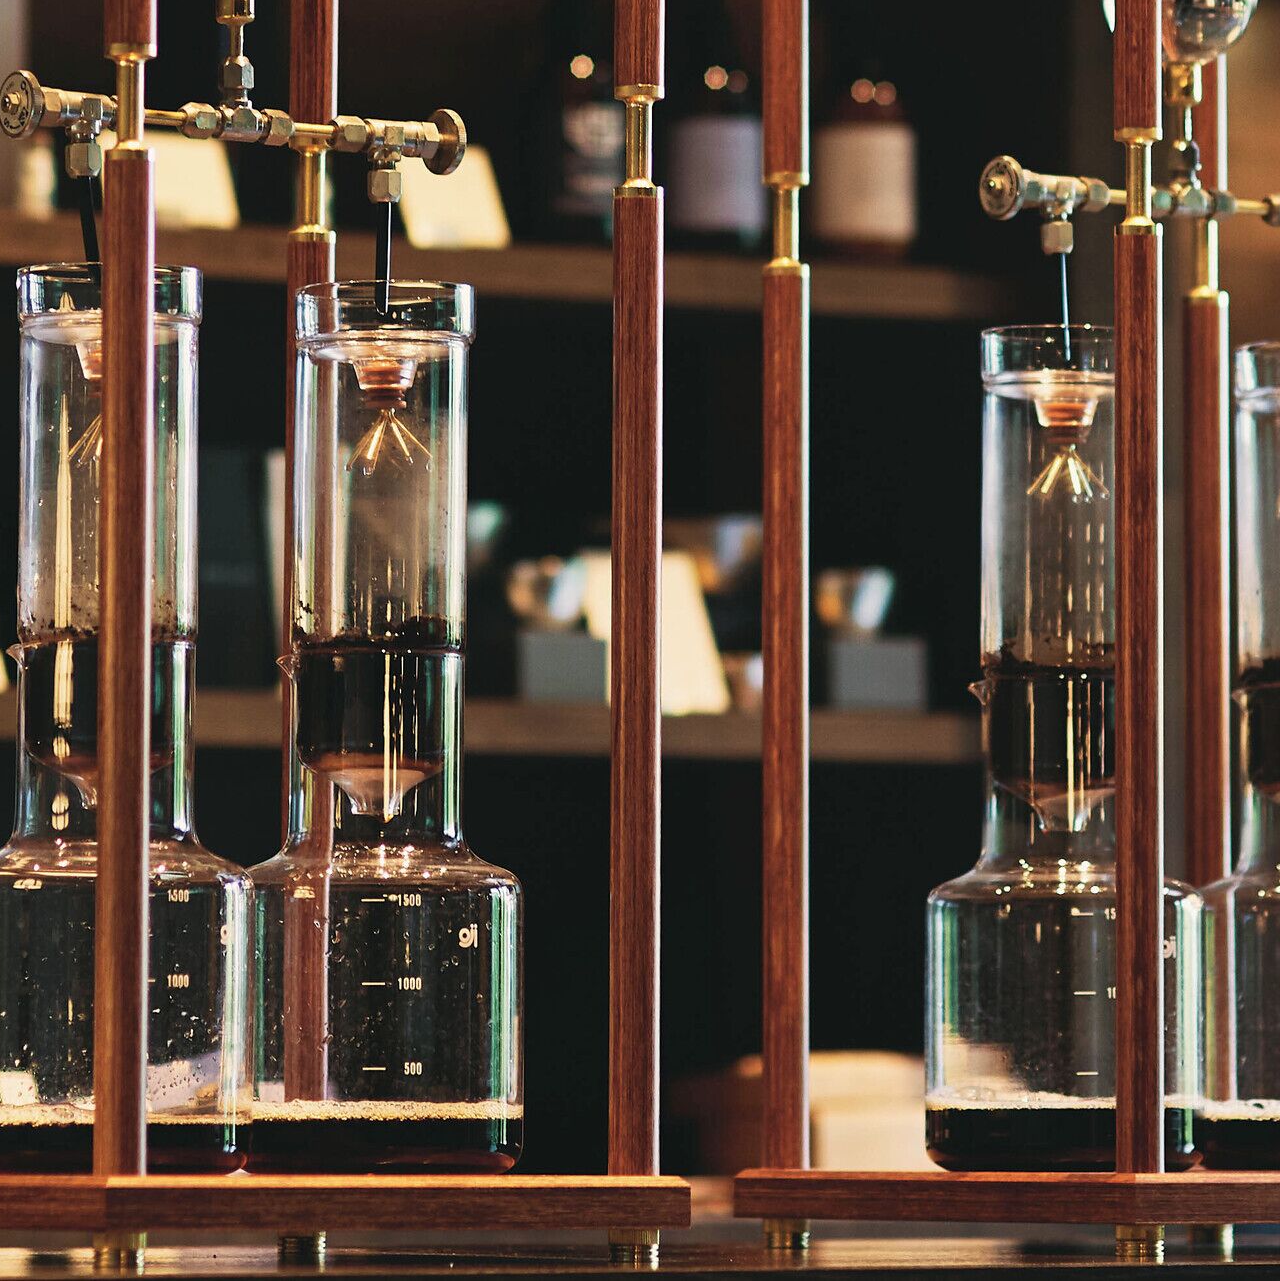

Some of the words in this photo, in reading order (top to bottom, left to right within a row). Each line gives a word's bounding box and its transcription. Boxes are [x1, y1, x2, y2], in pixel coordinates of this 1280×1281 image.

[167, 889, 190, 902] 1500
[397, 893, 422, 906] 1500
[167, 974, 190, 988] 1000
[397, 977, 422, 990] 1000
[404, 1062, 423, 1075] 500
